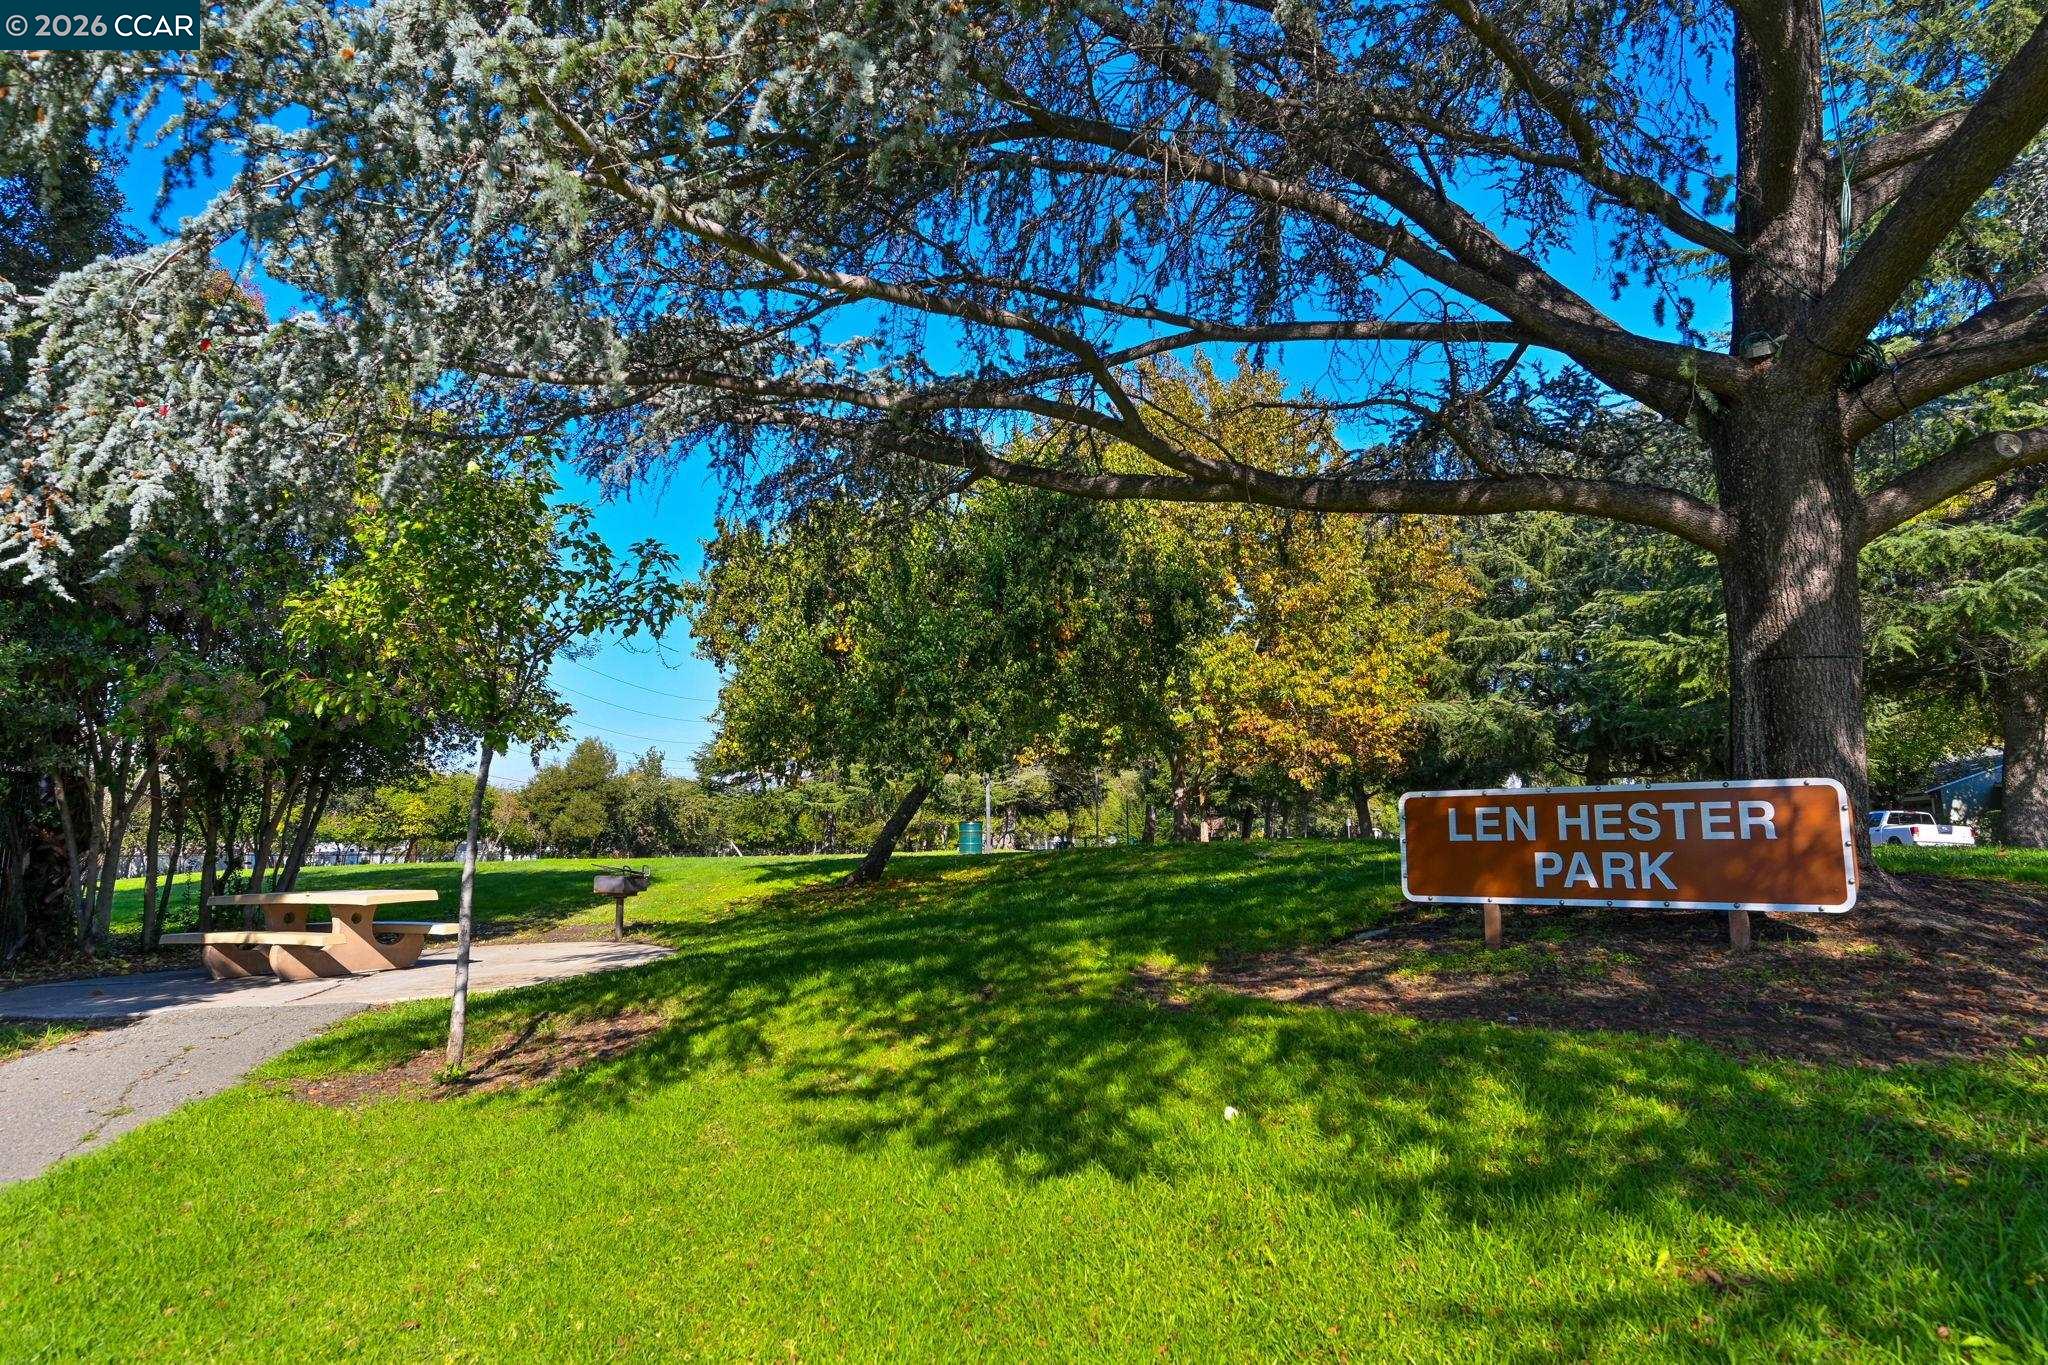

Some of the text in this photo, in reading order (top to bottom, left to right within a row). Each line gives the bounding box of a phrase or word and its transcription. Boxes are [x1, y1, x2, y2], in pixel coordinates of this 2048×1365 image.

[1448, 800, 1778, 842] LEN HESTER
[1534, 851, 1679, 890] PARK
